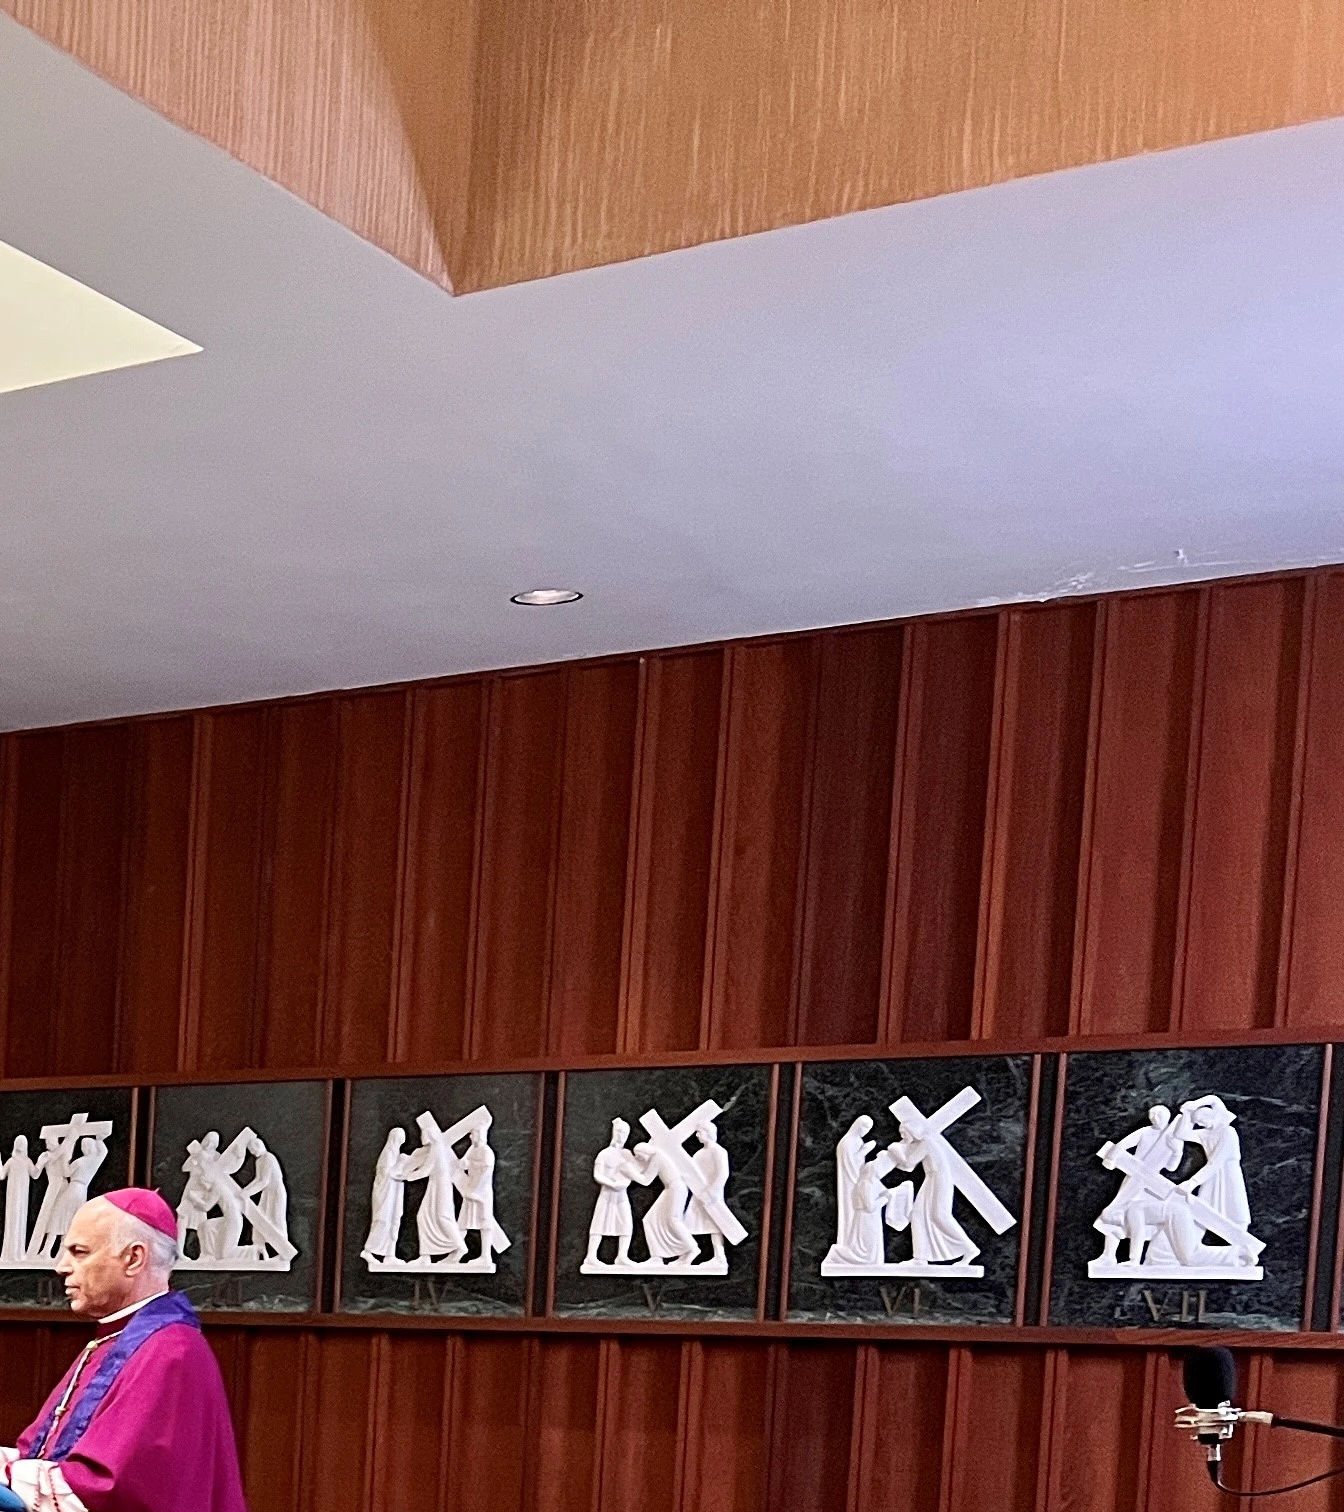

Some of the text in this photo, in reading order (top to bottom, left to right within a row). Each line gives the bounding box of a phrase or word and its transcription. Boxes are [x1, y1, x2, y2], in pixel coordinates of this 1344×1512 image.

[414, 1280, 451, 1305] IV
[642, 1283, 665, 1312] V
[879, 1286, 921, 1316] VI
[1143, 1290, 1207, 1322] VII
